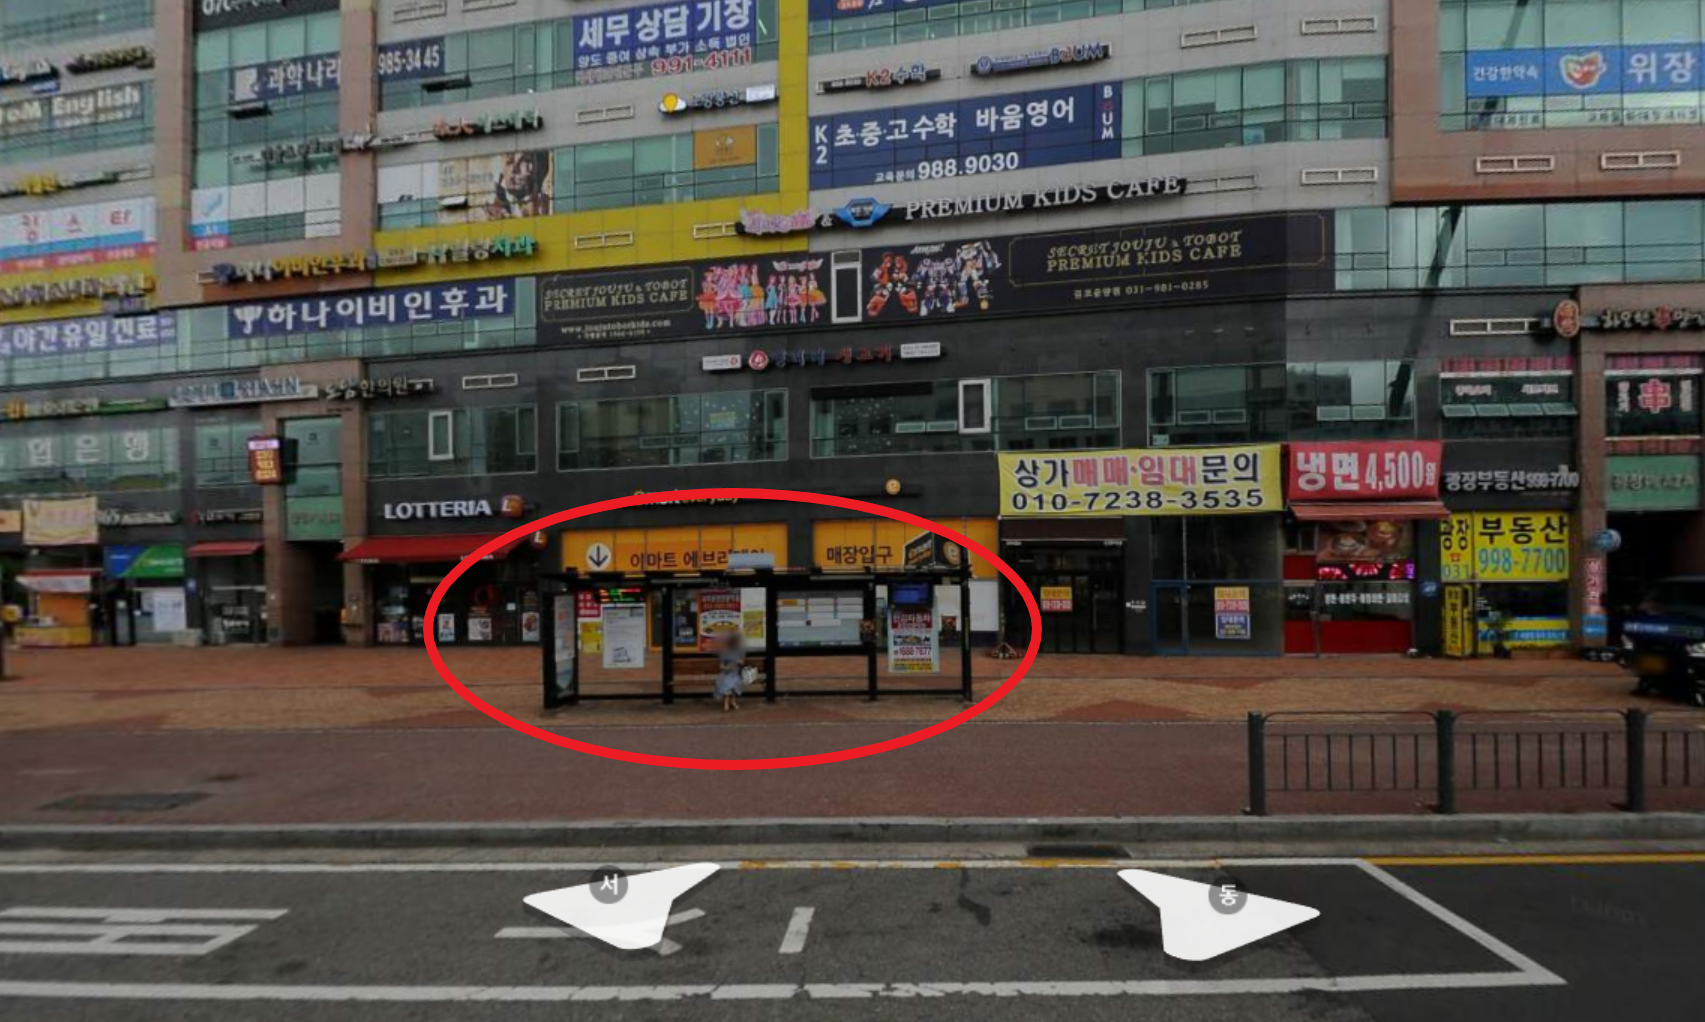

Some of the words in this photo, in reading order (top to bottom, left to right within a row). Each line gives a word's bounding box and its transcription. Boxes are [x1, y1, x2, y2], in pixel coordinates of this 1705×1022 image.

[579, 13, 630, 49] 세무
[635, 5, 690, 42] 상담
[697, 0, 751, 32] 기장
[652, 47, 752, 76] 991-4111
[1627, 51, 1699, 83] 위장
[976, 97, 1075, 132] 바움영어
[918, 152, 1019, 181] 988.9030
[905, 189, 1024, 220] PREMIUM
[1033, 183, 1097, 211] KIDS
[1106, 176, 1182, 202] CAFE
[1183, 230, 1242, 248] TOBOT
[1047, 252, 1130, 272] PREMIUM
[1137, 248, 1183, 265] KIDS
[1190, 243, 1242, 261] CAFE
[267, 284, 508, 331] 하나이비인후과
[544, 295, 607, 311] PREMIUM
[611, 292, 645, 307] KIDS
[650, 289, 688, 302] CAFE
[1296, 451, 1360, 492] 냉면
[1364, 450, 1437, 489] 4,500원
[384, 499, 493, 520] LOTTERIA
[1012, 488, 1264, 511] 010-7238-3535
[1478, 516, 1568, 545] 부동산
[630, 552, 678, 569] 이마트
[827, 545, 893, 564] 매장입구
[1478, 547, 1567, 574] 998-7700
